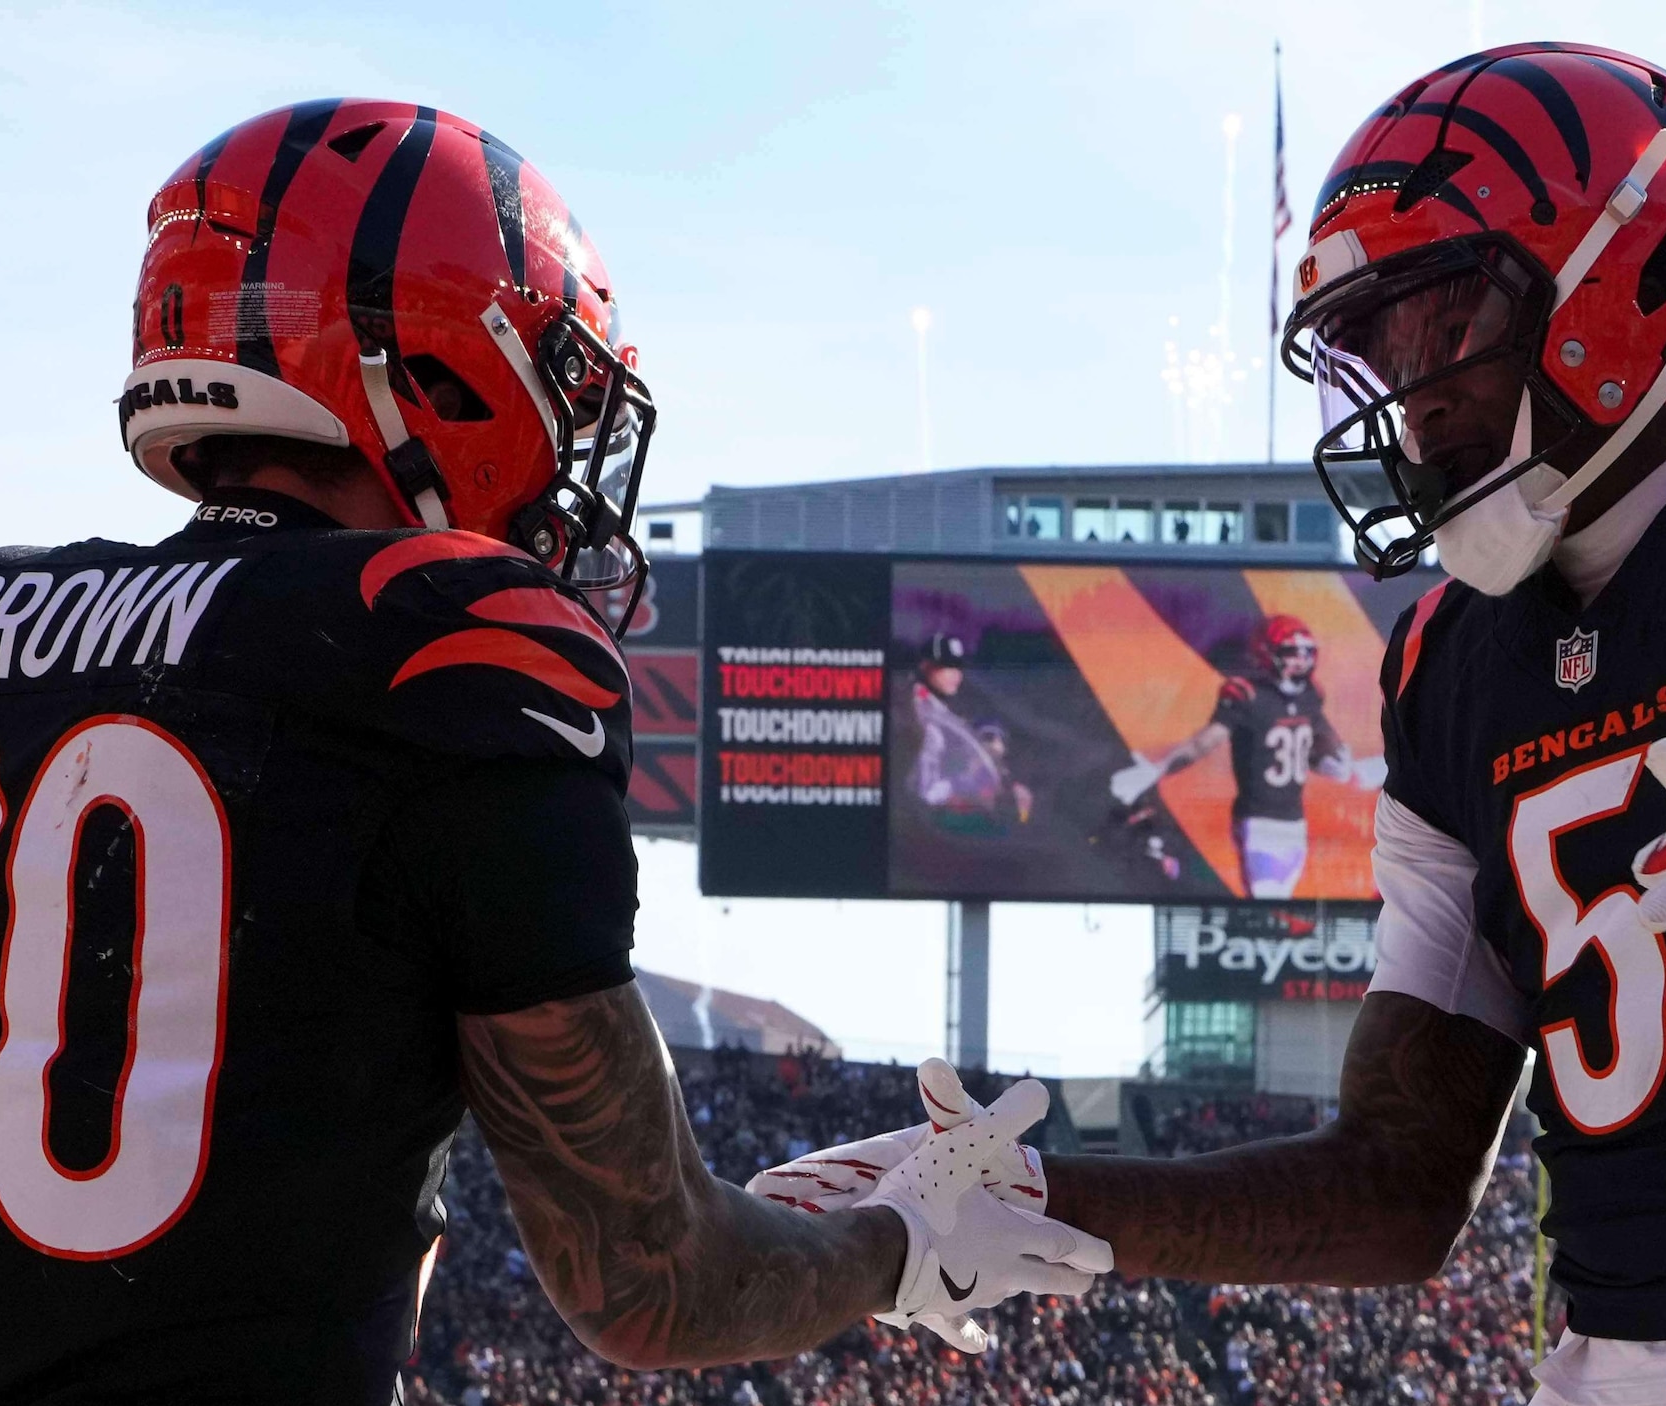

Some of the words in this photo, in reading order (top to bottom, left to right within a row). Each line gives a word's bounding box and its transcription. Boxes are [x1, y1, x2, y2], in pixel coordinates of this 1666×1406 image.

[240, 282, 285, 290] WARNING
[219, 506, 278, 528] PRO
[718, 665, 883, 699] TOUCHDOWN!
[1561, 655, 1590, 680] NFL
[718, 707, 884, 745] TOUCHDOWN!
[718, 751, 883, 786] TOUCHDOWN!
[1264, 725, 1314, 787] 30
[1183, 923, 1376, 985] Payco
